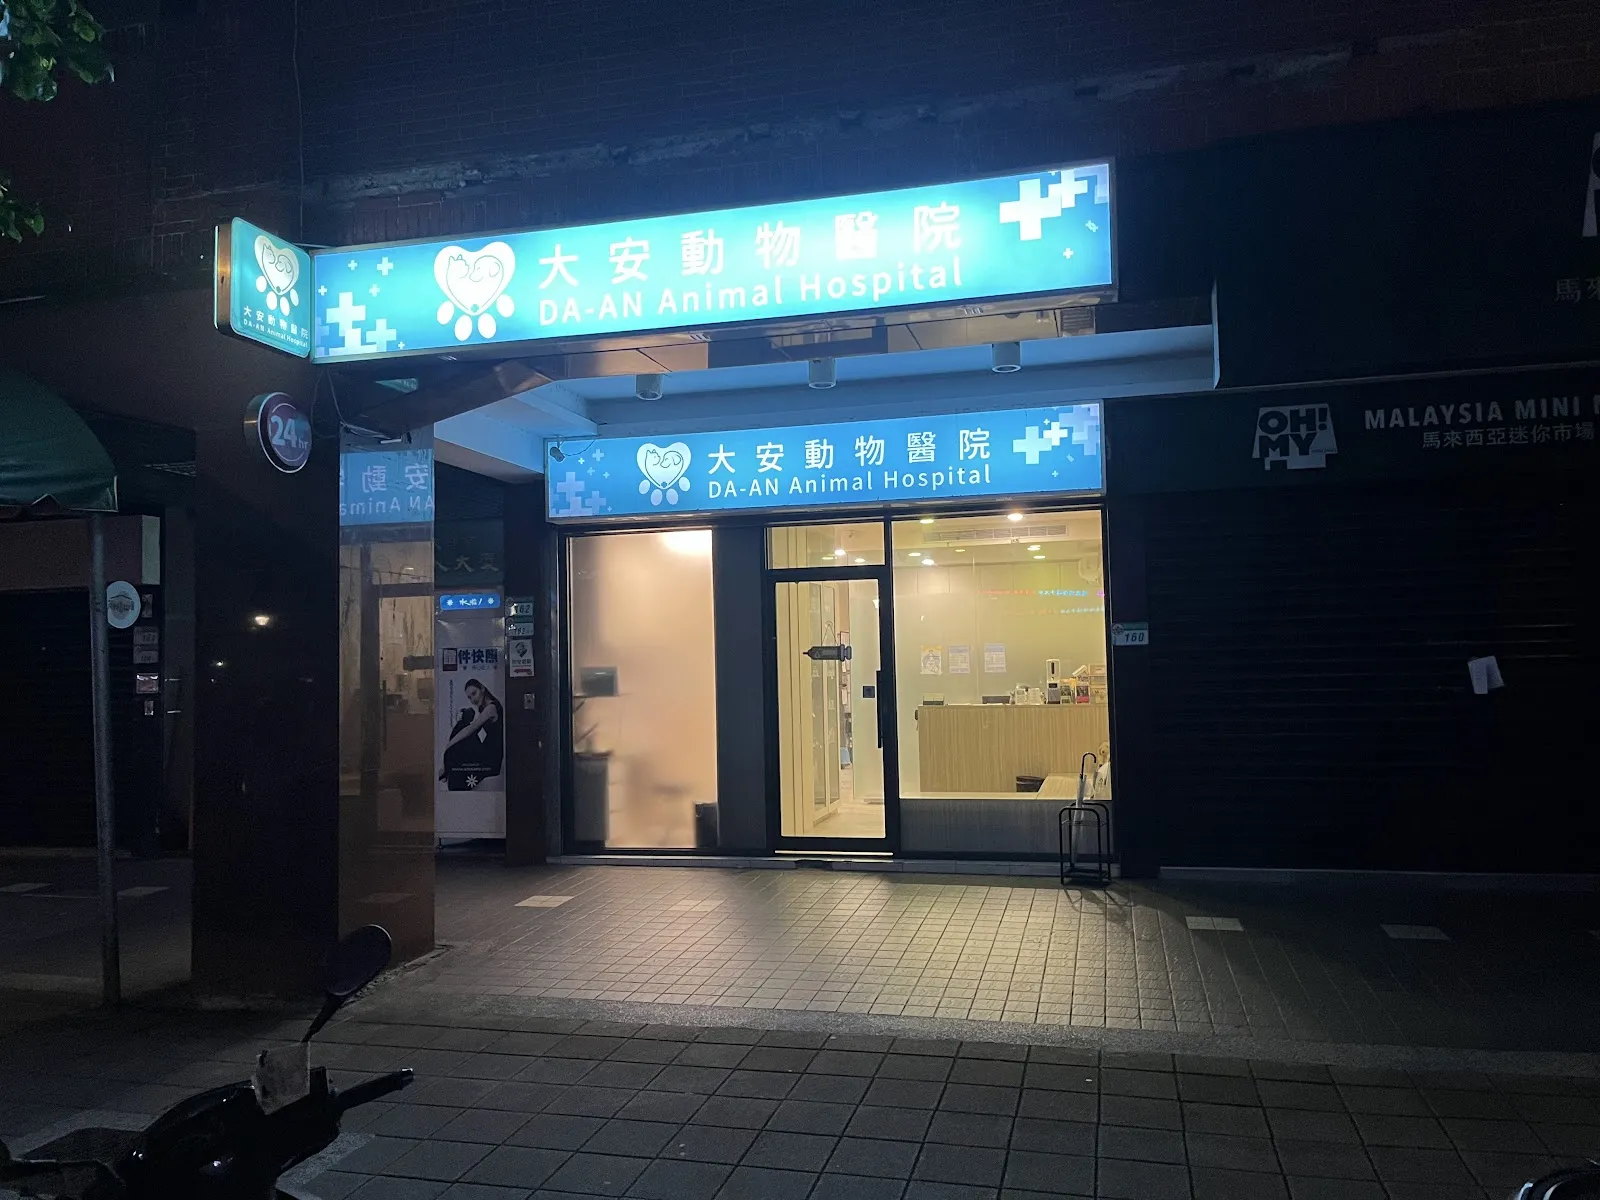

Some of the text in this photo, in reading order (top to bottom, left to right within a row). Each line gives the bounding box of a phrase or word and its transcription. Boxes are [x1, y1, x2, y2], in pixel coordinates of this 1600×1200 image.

[539, 200, 962, 290] 大安動物醫院
[540, 254, 962, 327] DA-AN Animal Hospital
[267, 327, 286, 340] Animal
[1363, 400, 1504, 431] MALAYSIA
[1514, 395, 1581, 421] MINI
[707, 427, 991, 475] 大安動物醫院
[1422, 420, 1596, 450] 馬來西亞迷你市場
[708, 464, 991, 499] DA-AN Animal Hospital
[1124, 632, 1145, 643] 160
